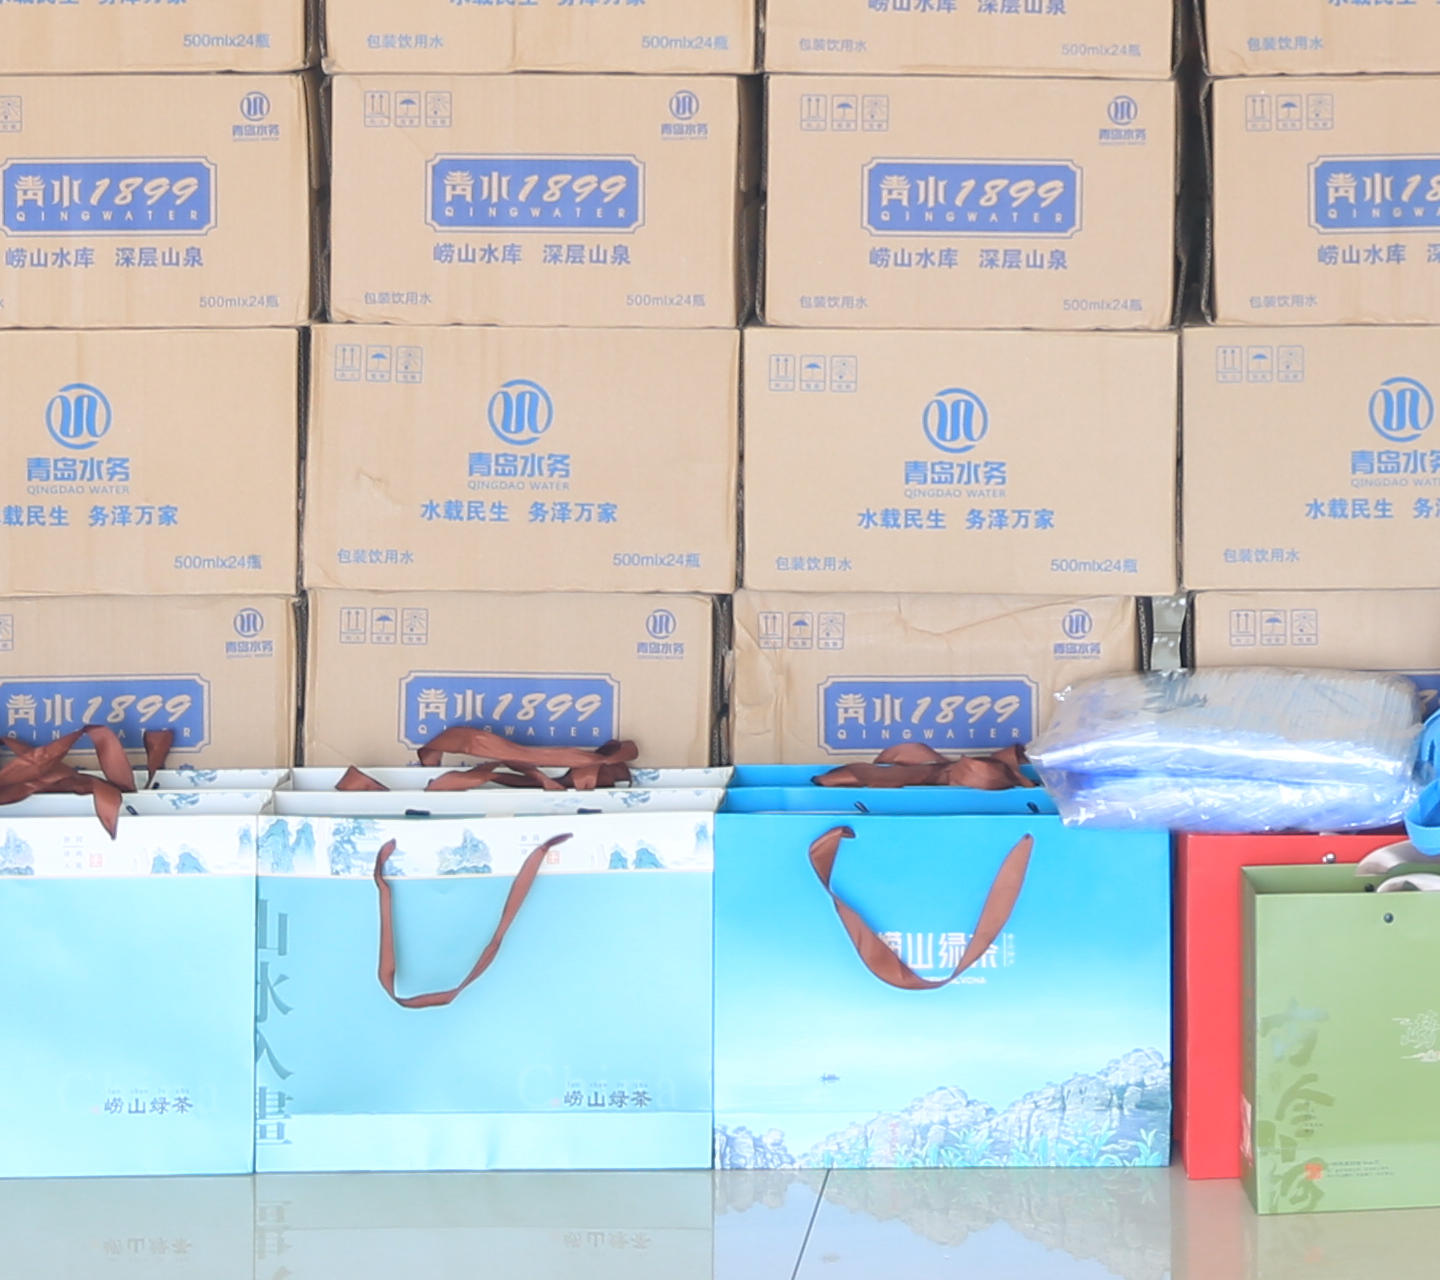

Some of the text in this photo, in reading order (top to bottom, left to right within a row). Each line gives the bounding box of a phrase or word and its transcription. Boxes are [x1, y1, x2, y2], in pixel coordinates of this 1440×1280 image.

[1246, 35, 1324, 52] 包装饮用水
[5, 246, 203, 268] 崂山水库 深层山泉
[433, 243, 630, 265] 崂山水库 深层山泉
[869, 247, 1067, 270] 崂山水库 深层山泉
[1318, 244, 1405, 265] 崂山水库
[27, 457, 131, 482] 青岛水务
[468, 452, 571, 478] 青岛水务
[904, 460, 1007, 485] 青岛水务
[467, 480, 571, 491] QINGDAO WATER
[89, 504, 179, 527] 务泽万家
[420, 499, 619, 524] 水载民生 务泽万家
[858, 508, 1055, 530] 水载民生 务泽万家
[1305, 498, 1393, 520] 水载民生
[104, 1096, 194, 1115] 崂山绿茶
[563, 1090, 652, 1108] 崂山绿茶
